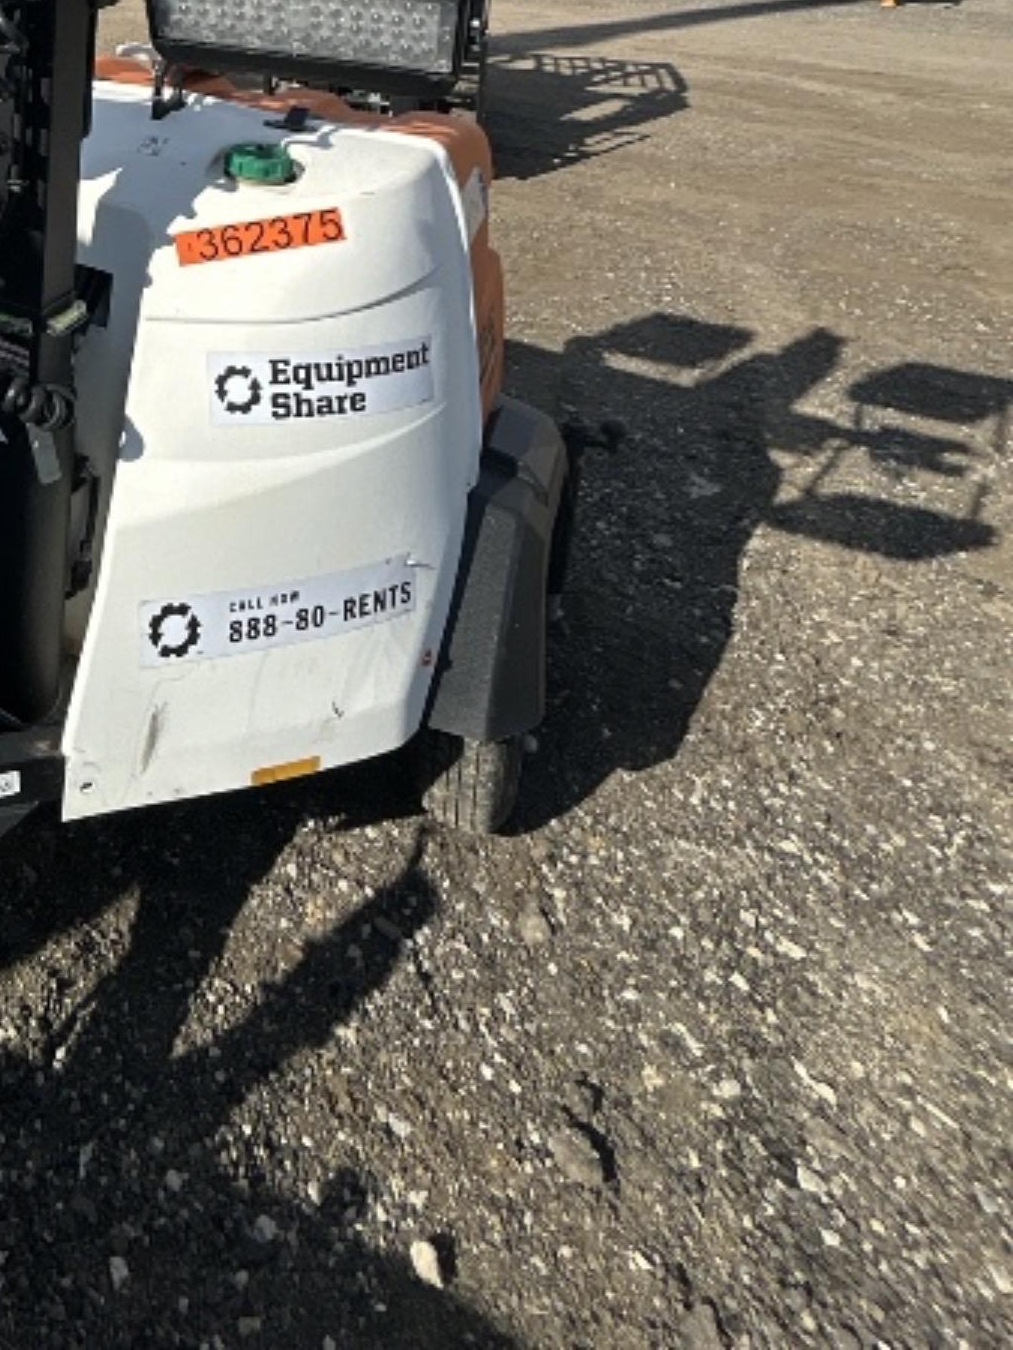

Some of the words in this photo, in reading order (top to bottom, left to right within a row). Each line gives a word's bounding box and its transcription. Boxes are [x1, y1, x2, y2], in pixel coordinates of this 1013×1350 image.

[196, 209, 344, 262] 362375
[269, 342, 430, 390] Equipment
[269, 391, 366, 419] Share
[229, 597, 263, 613] CALL
[229, 581, 412, 643] 888-80-RENTS
